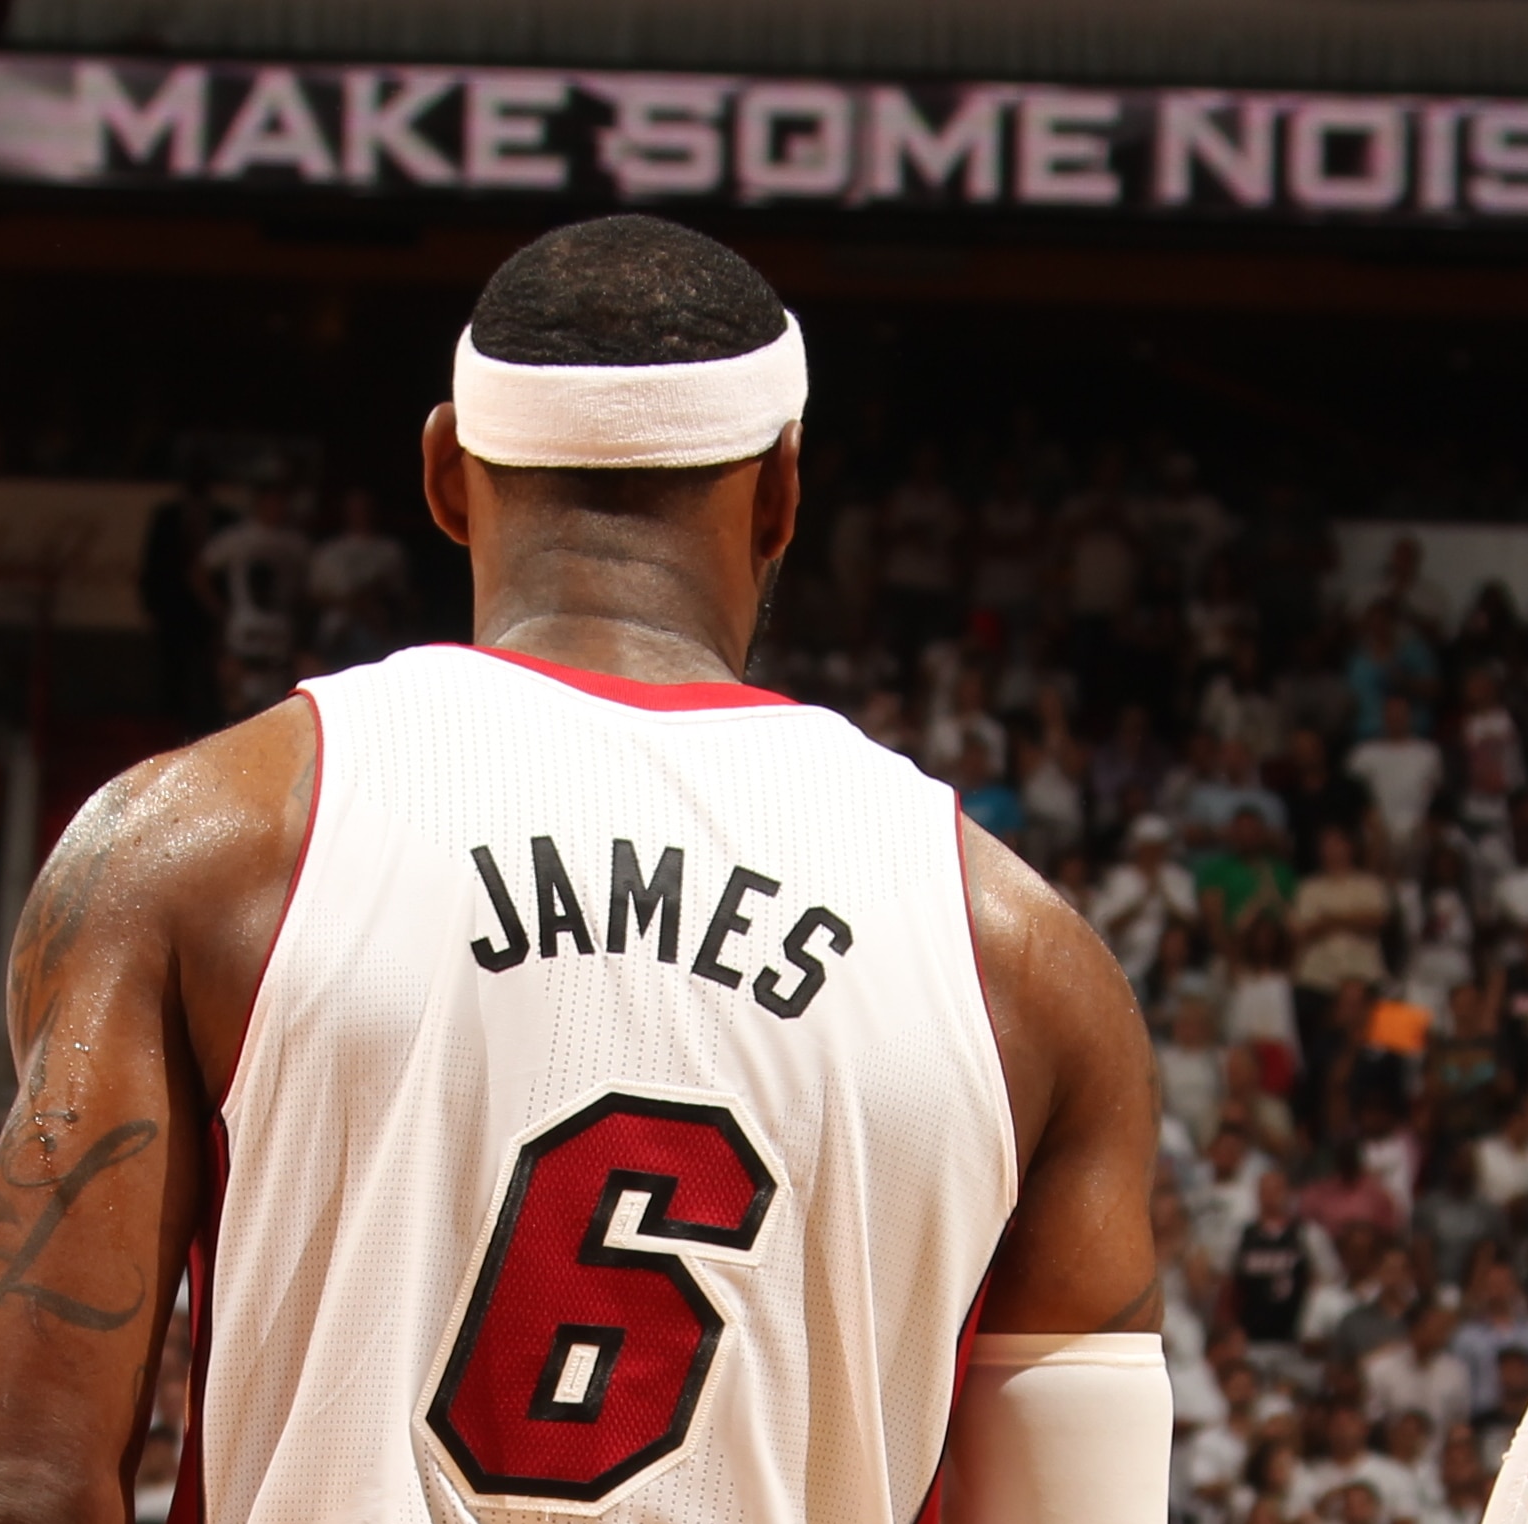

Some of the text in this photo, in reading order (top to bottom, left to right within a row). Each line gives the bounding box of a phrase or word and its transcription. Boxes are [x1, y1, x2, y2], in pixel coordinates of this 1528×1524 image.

[77, 64, 569, 190] MAKE
[599, 78, 1123, 206] SOME
[470, 836, 854, 1020] JAMES
[421, 1088, 784, 1503] 6
